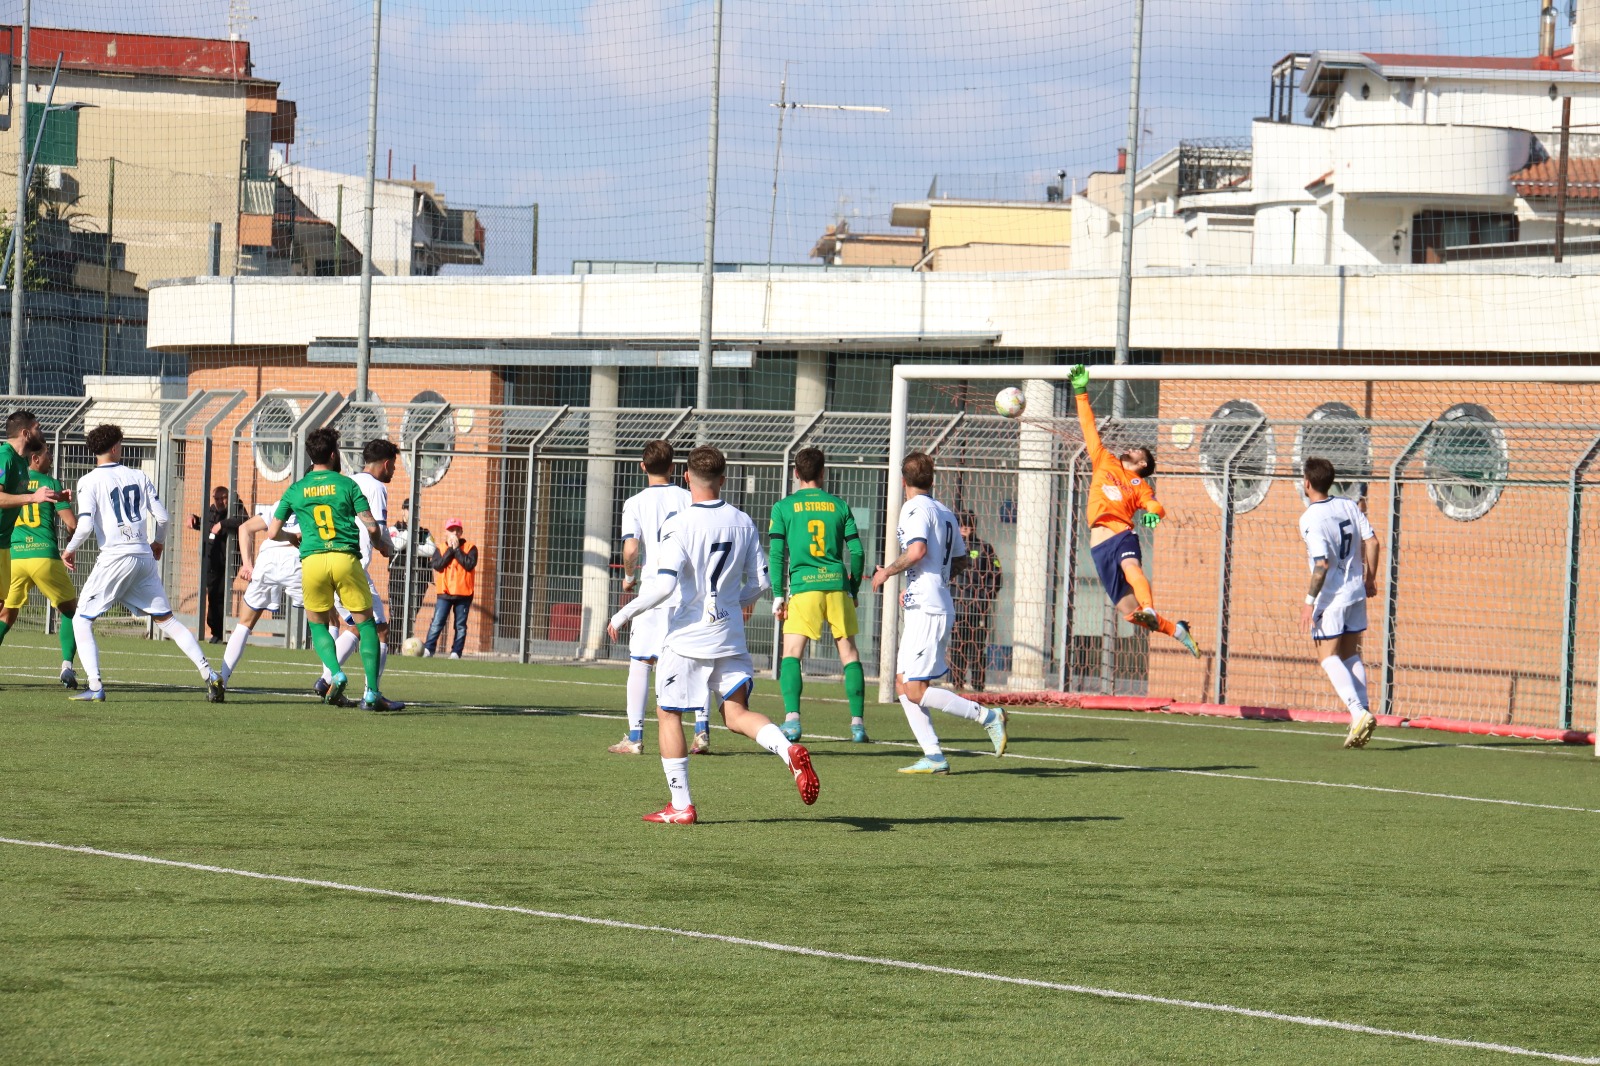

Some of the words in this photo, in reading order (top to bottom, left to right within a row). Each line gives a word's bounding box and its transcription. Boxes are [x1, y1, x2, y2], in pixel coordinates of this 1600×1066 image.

[110, 484, 142, 528] 10
[303, 484, 336, 498] MAIONE
[793, 501, 803, 513] DI
[805, 501, 835, 512] STASIO
[313, 504, 336, 540] 9
[807, 519, 825, 557] 3
[943, 521, 953, 566] 9
[710, 541, 733, 597] 7
